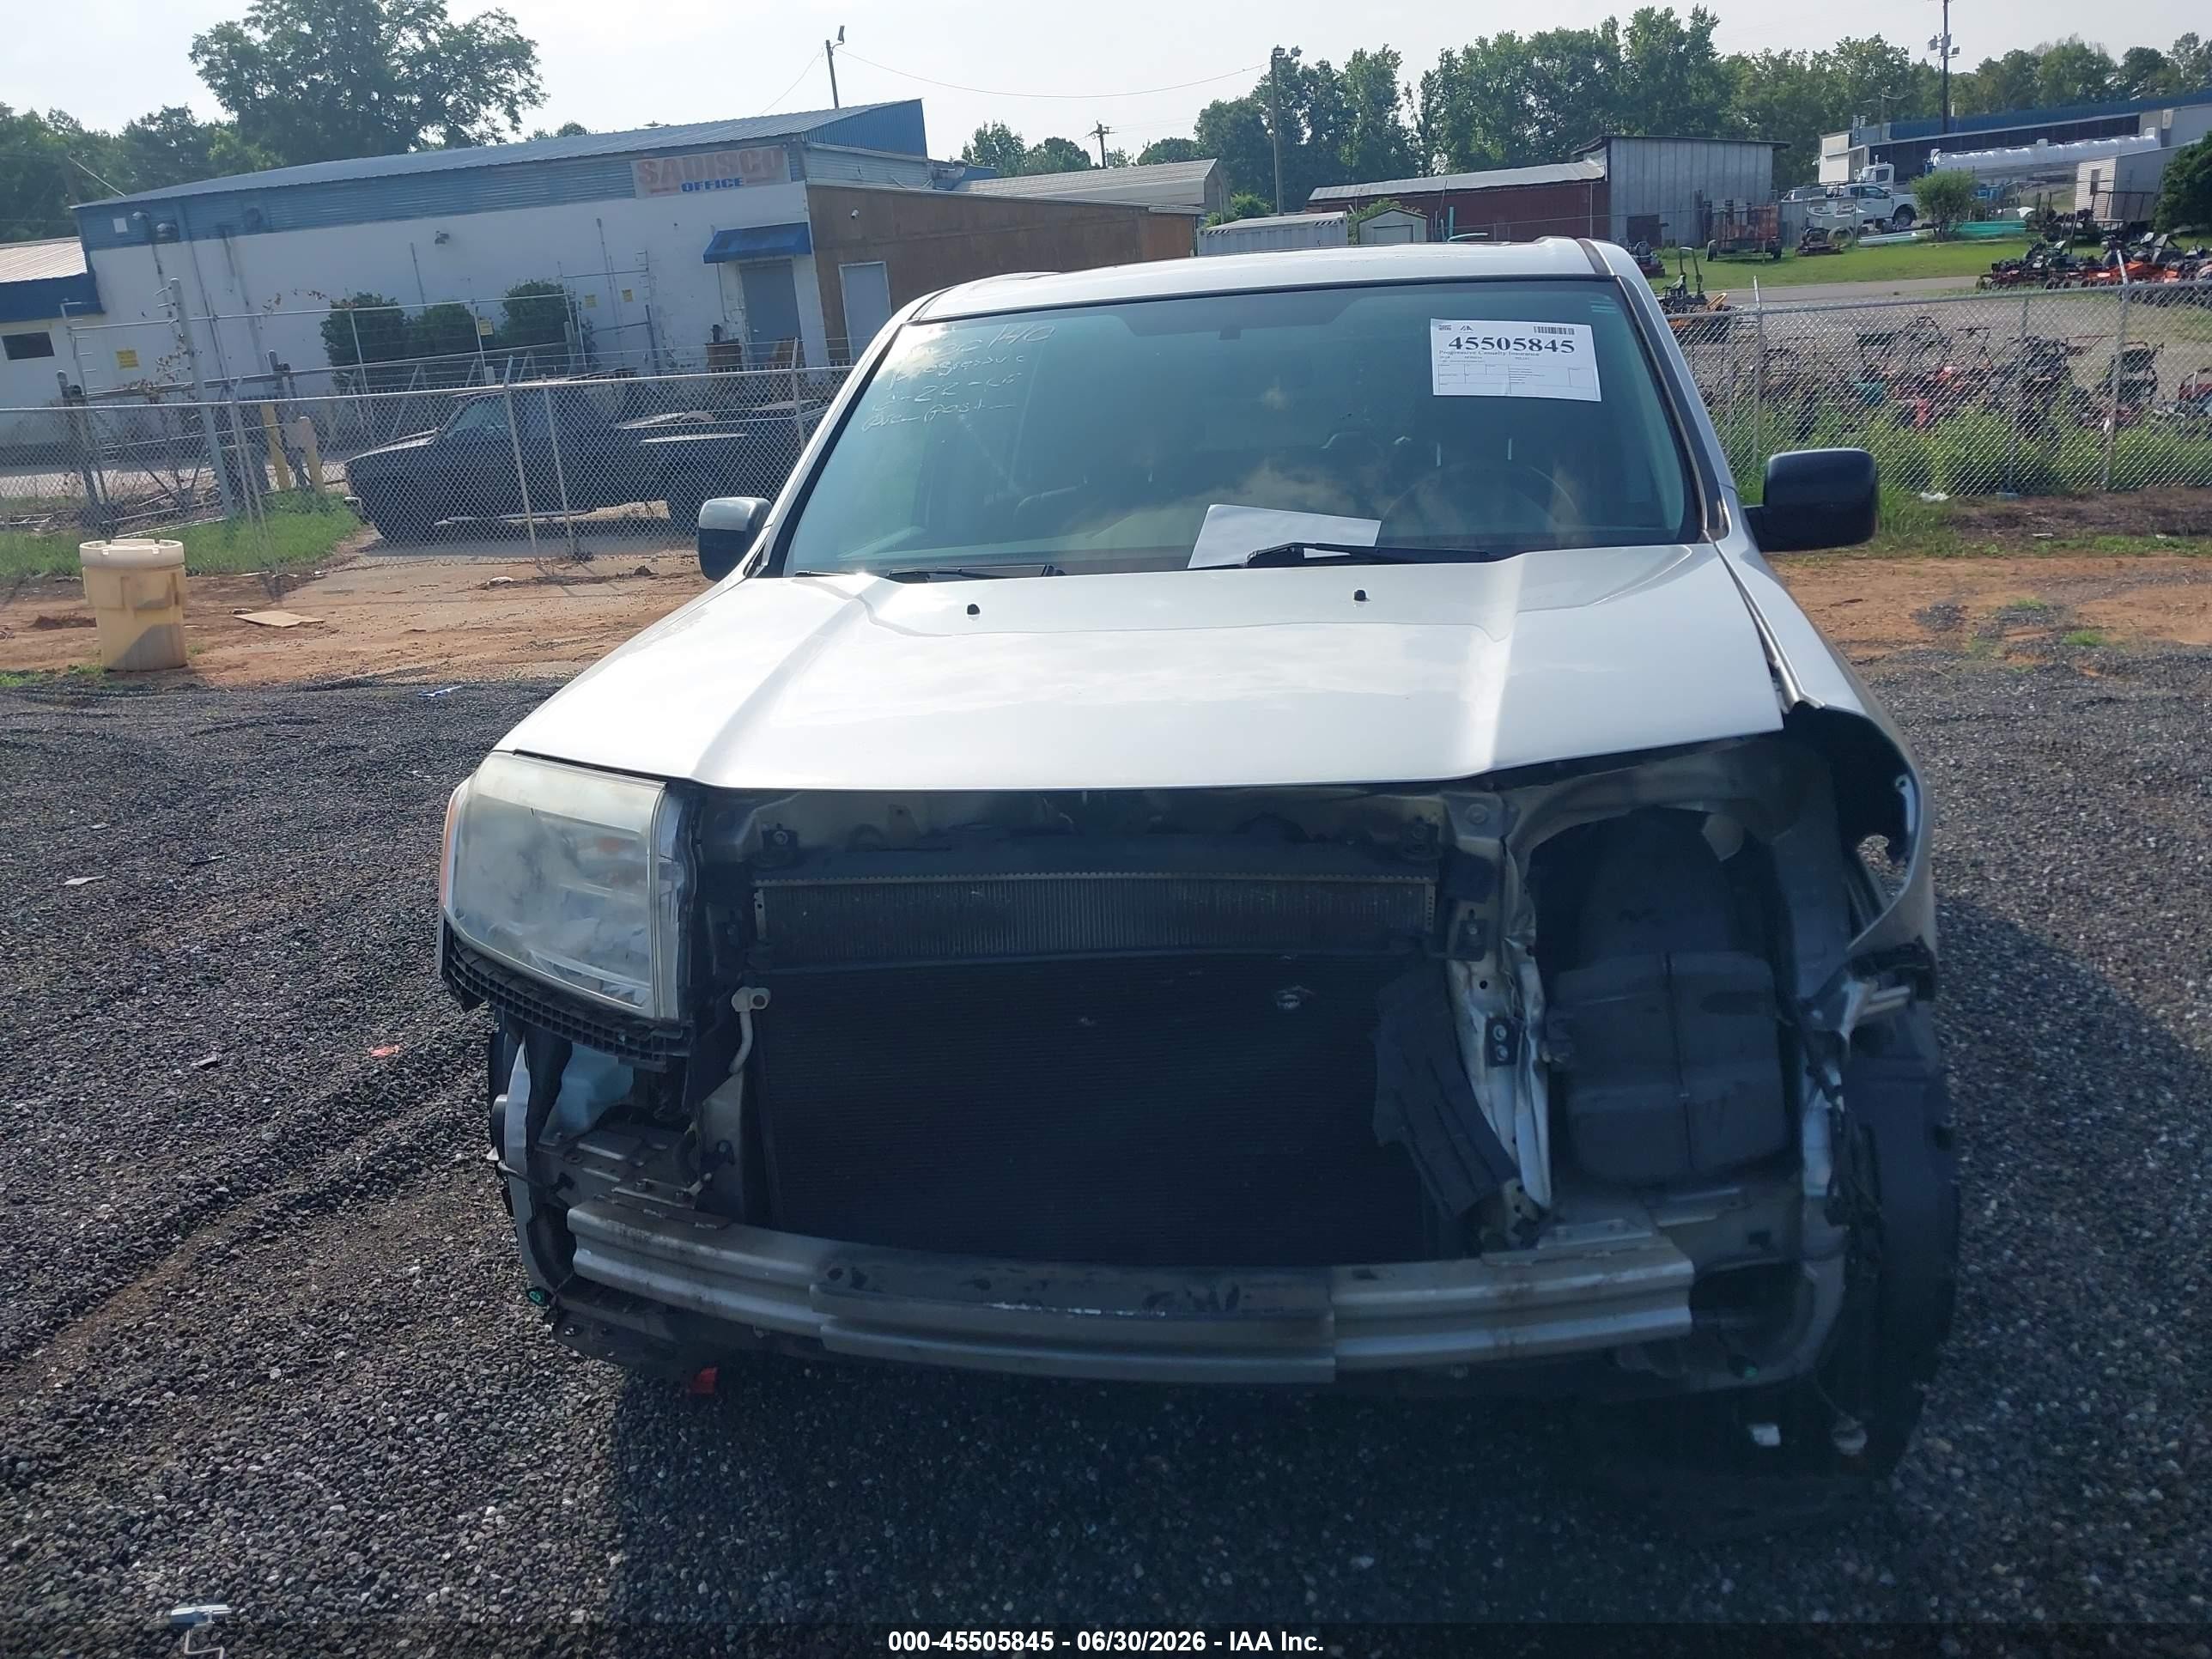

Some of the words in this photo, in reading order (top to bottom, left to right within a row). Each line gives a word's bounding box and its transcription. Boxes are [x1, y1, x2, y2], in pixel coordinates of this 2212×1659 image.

[638, 149, 783, 184] SADISCO
[681, 177, 744, 192] OFFICE
[1449, 337, 1575, 354] 45505845
